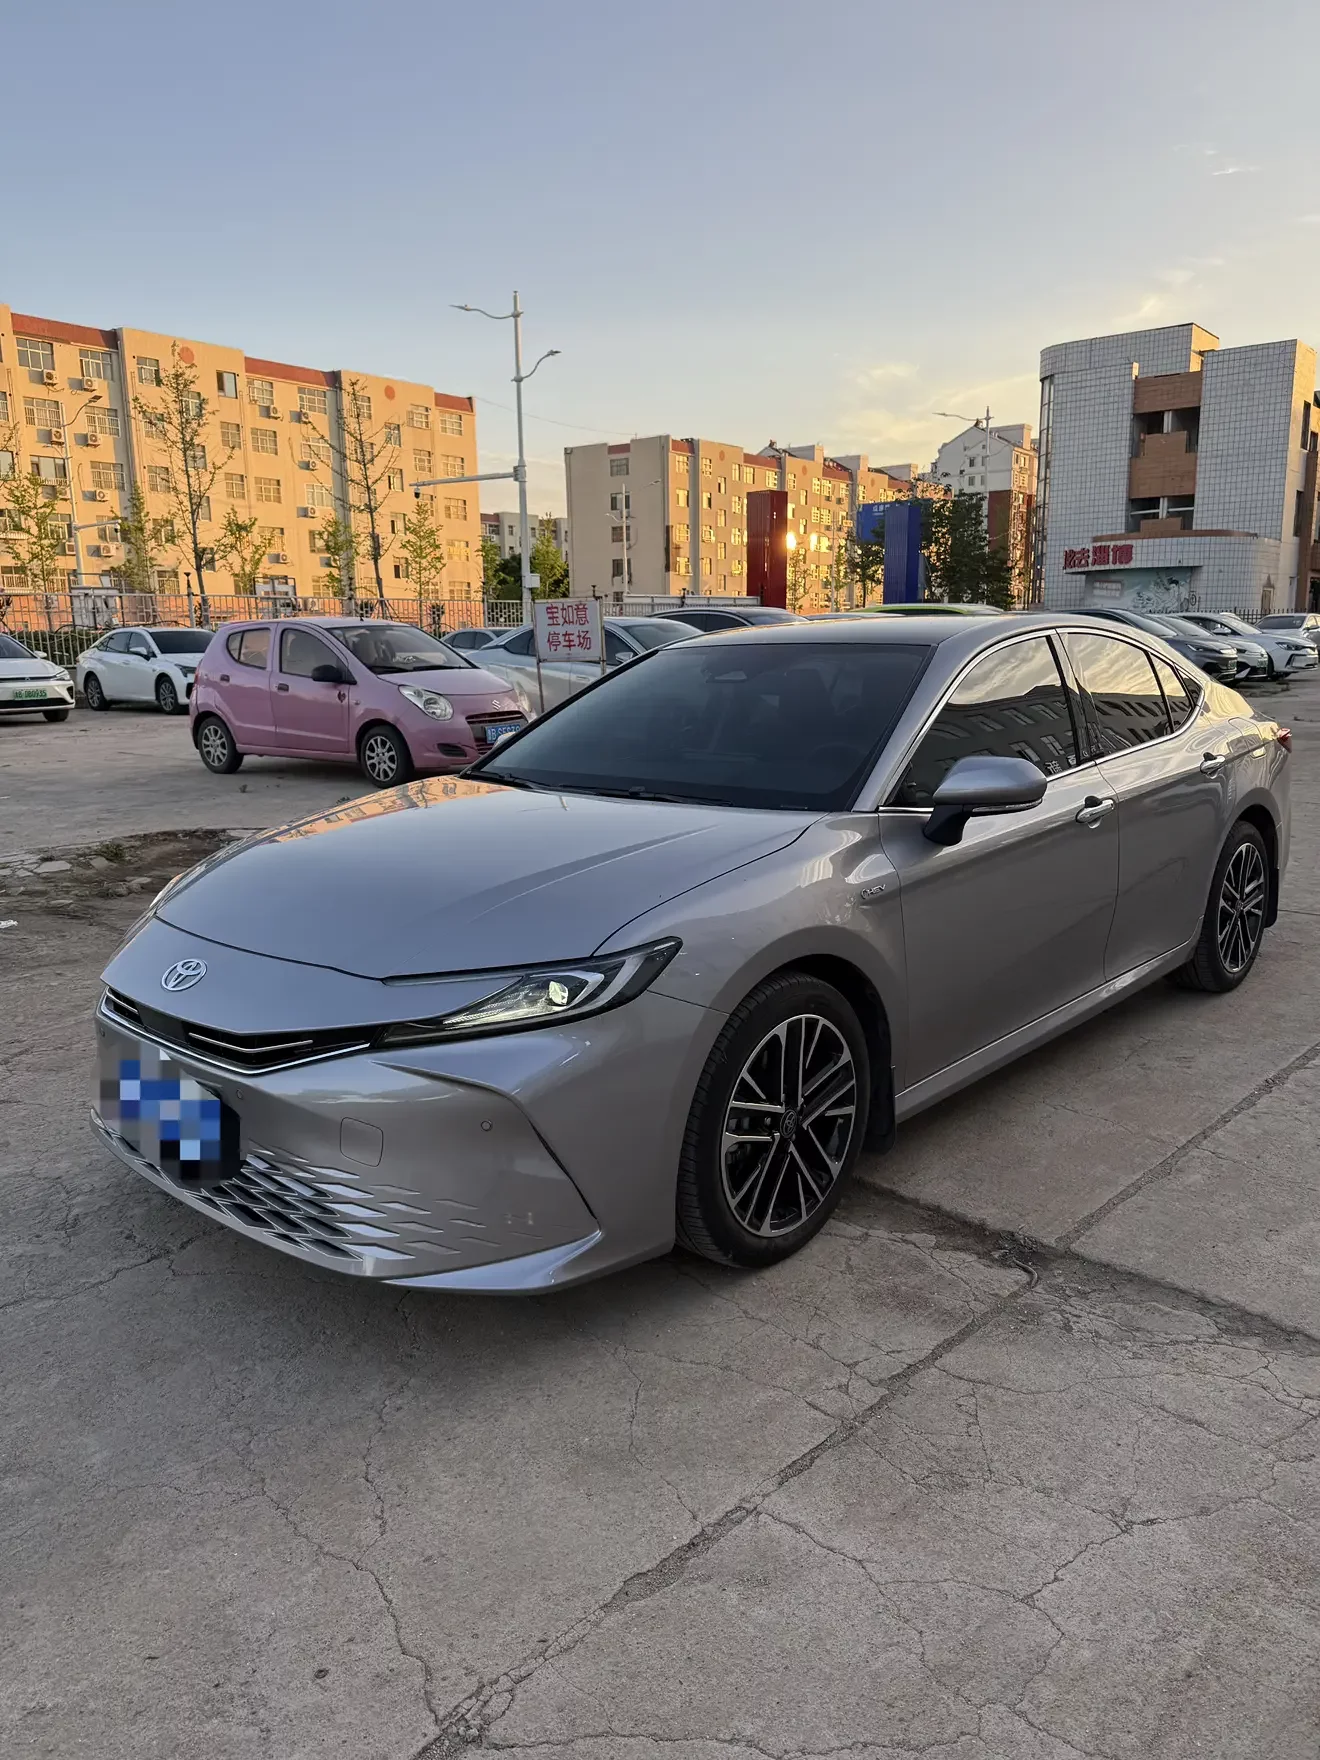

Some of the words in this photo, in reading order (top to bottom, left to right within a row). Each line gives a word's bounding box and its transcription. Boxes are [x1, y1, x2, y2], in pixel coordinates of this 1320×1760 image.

[546, 603, 589, 626] 宝如意
[547, 630, 592, 652] 停车场
